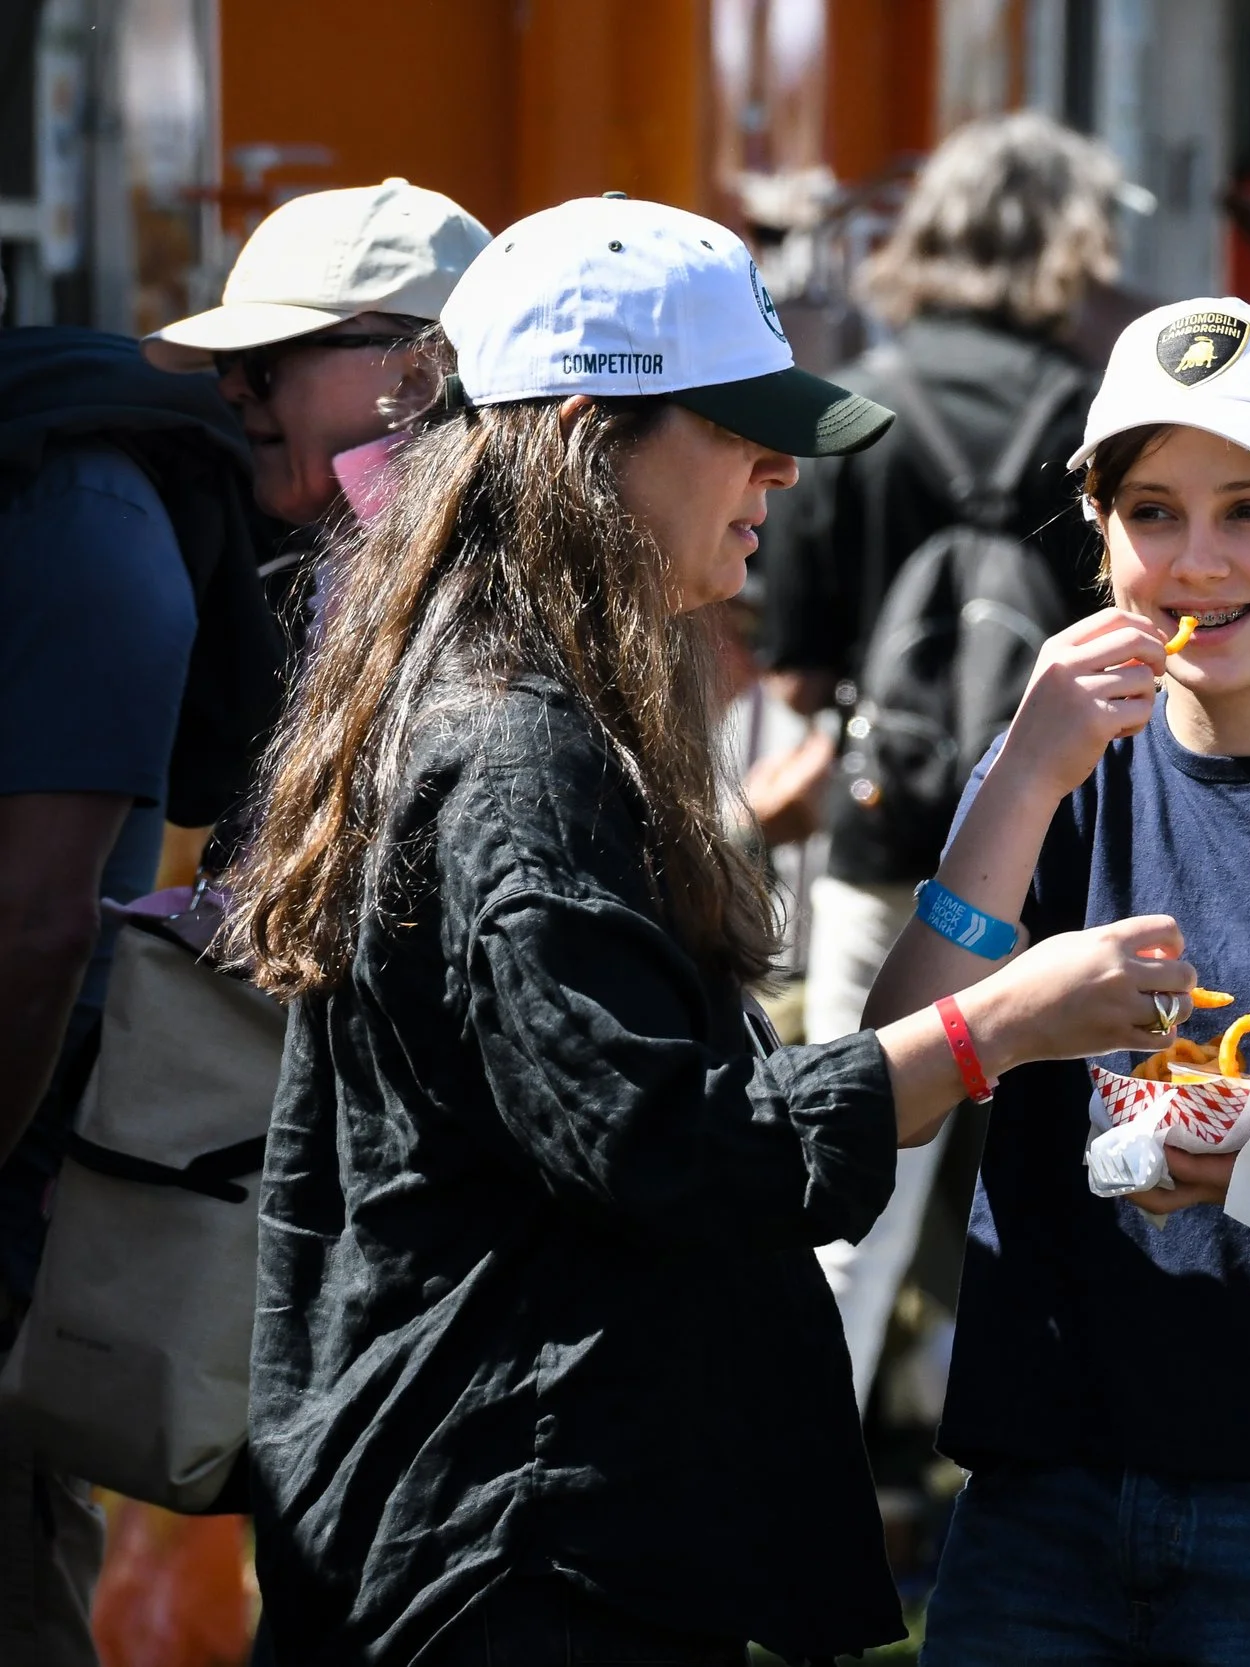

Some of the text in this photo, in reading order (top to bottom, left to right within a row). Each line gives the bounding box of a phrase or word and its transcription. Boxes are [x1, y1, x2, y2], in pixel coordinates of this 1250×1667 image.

[1162, 324, 1241, 343] LAMBORGHINI
[1169, 313, 1238, 332] AUTOMOBILI
[562, 353, 663, 375] COMPETITOR
[932, 902, 961, 927] ROCK
[937, 892, 966, 917] LIME
[928, 911, 957, 937] PARK
